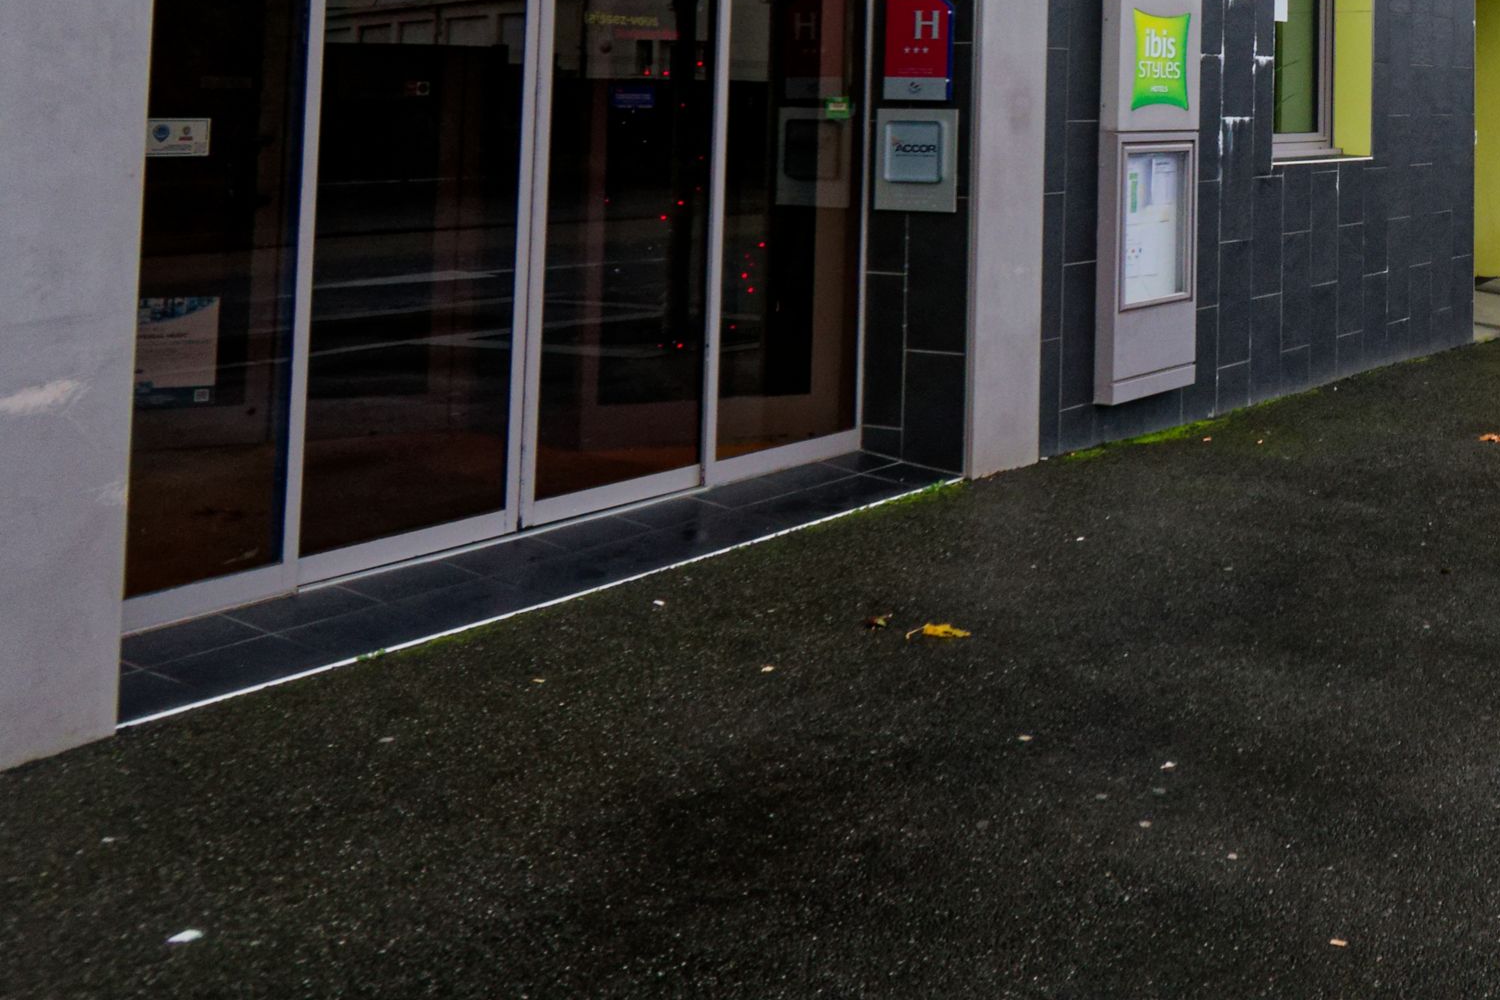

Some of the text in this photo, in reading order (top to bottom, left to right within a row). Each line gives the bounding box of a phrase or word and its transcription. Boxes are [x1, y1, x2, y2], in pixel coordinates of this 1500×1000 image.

[914, 10, 940, 40] H
[1144, 28, 1176, 59] ibis
[895, 143, 937, 153] ACCOR
